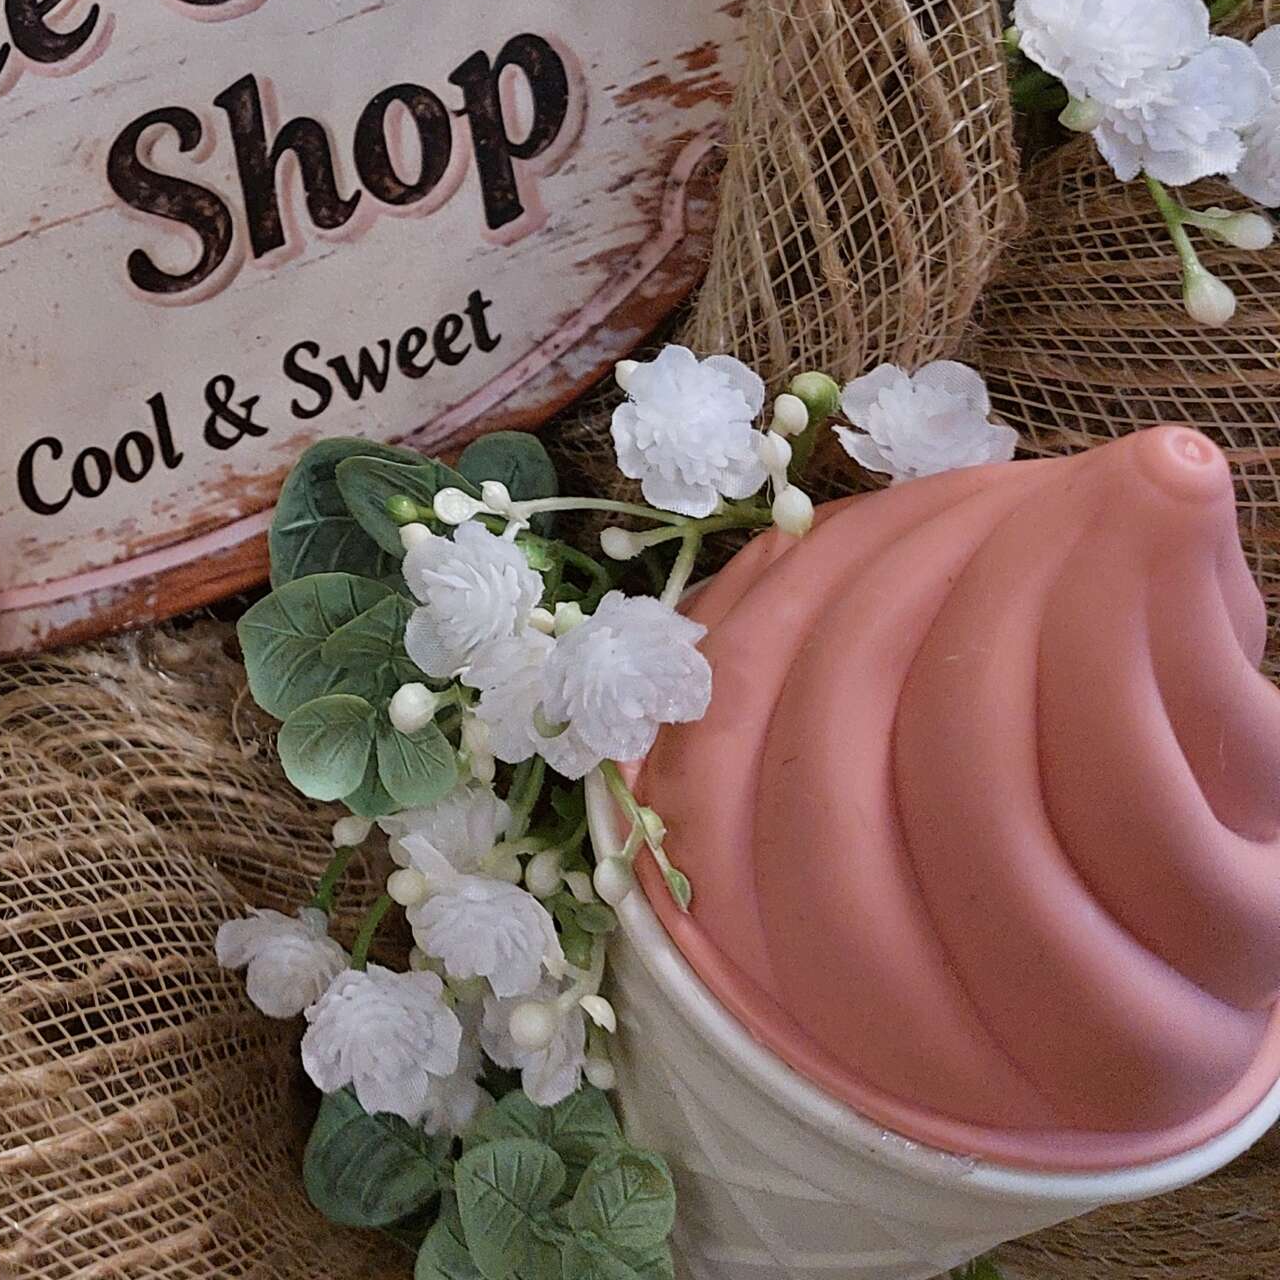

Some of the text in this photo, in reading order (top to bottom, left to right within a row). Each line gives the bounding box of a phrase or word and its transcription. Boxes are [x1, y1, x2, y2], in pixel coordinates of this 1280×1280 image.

[105, 31, 570, 295] Shop
[16, 288, 503, 517] Cool & Sweet
